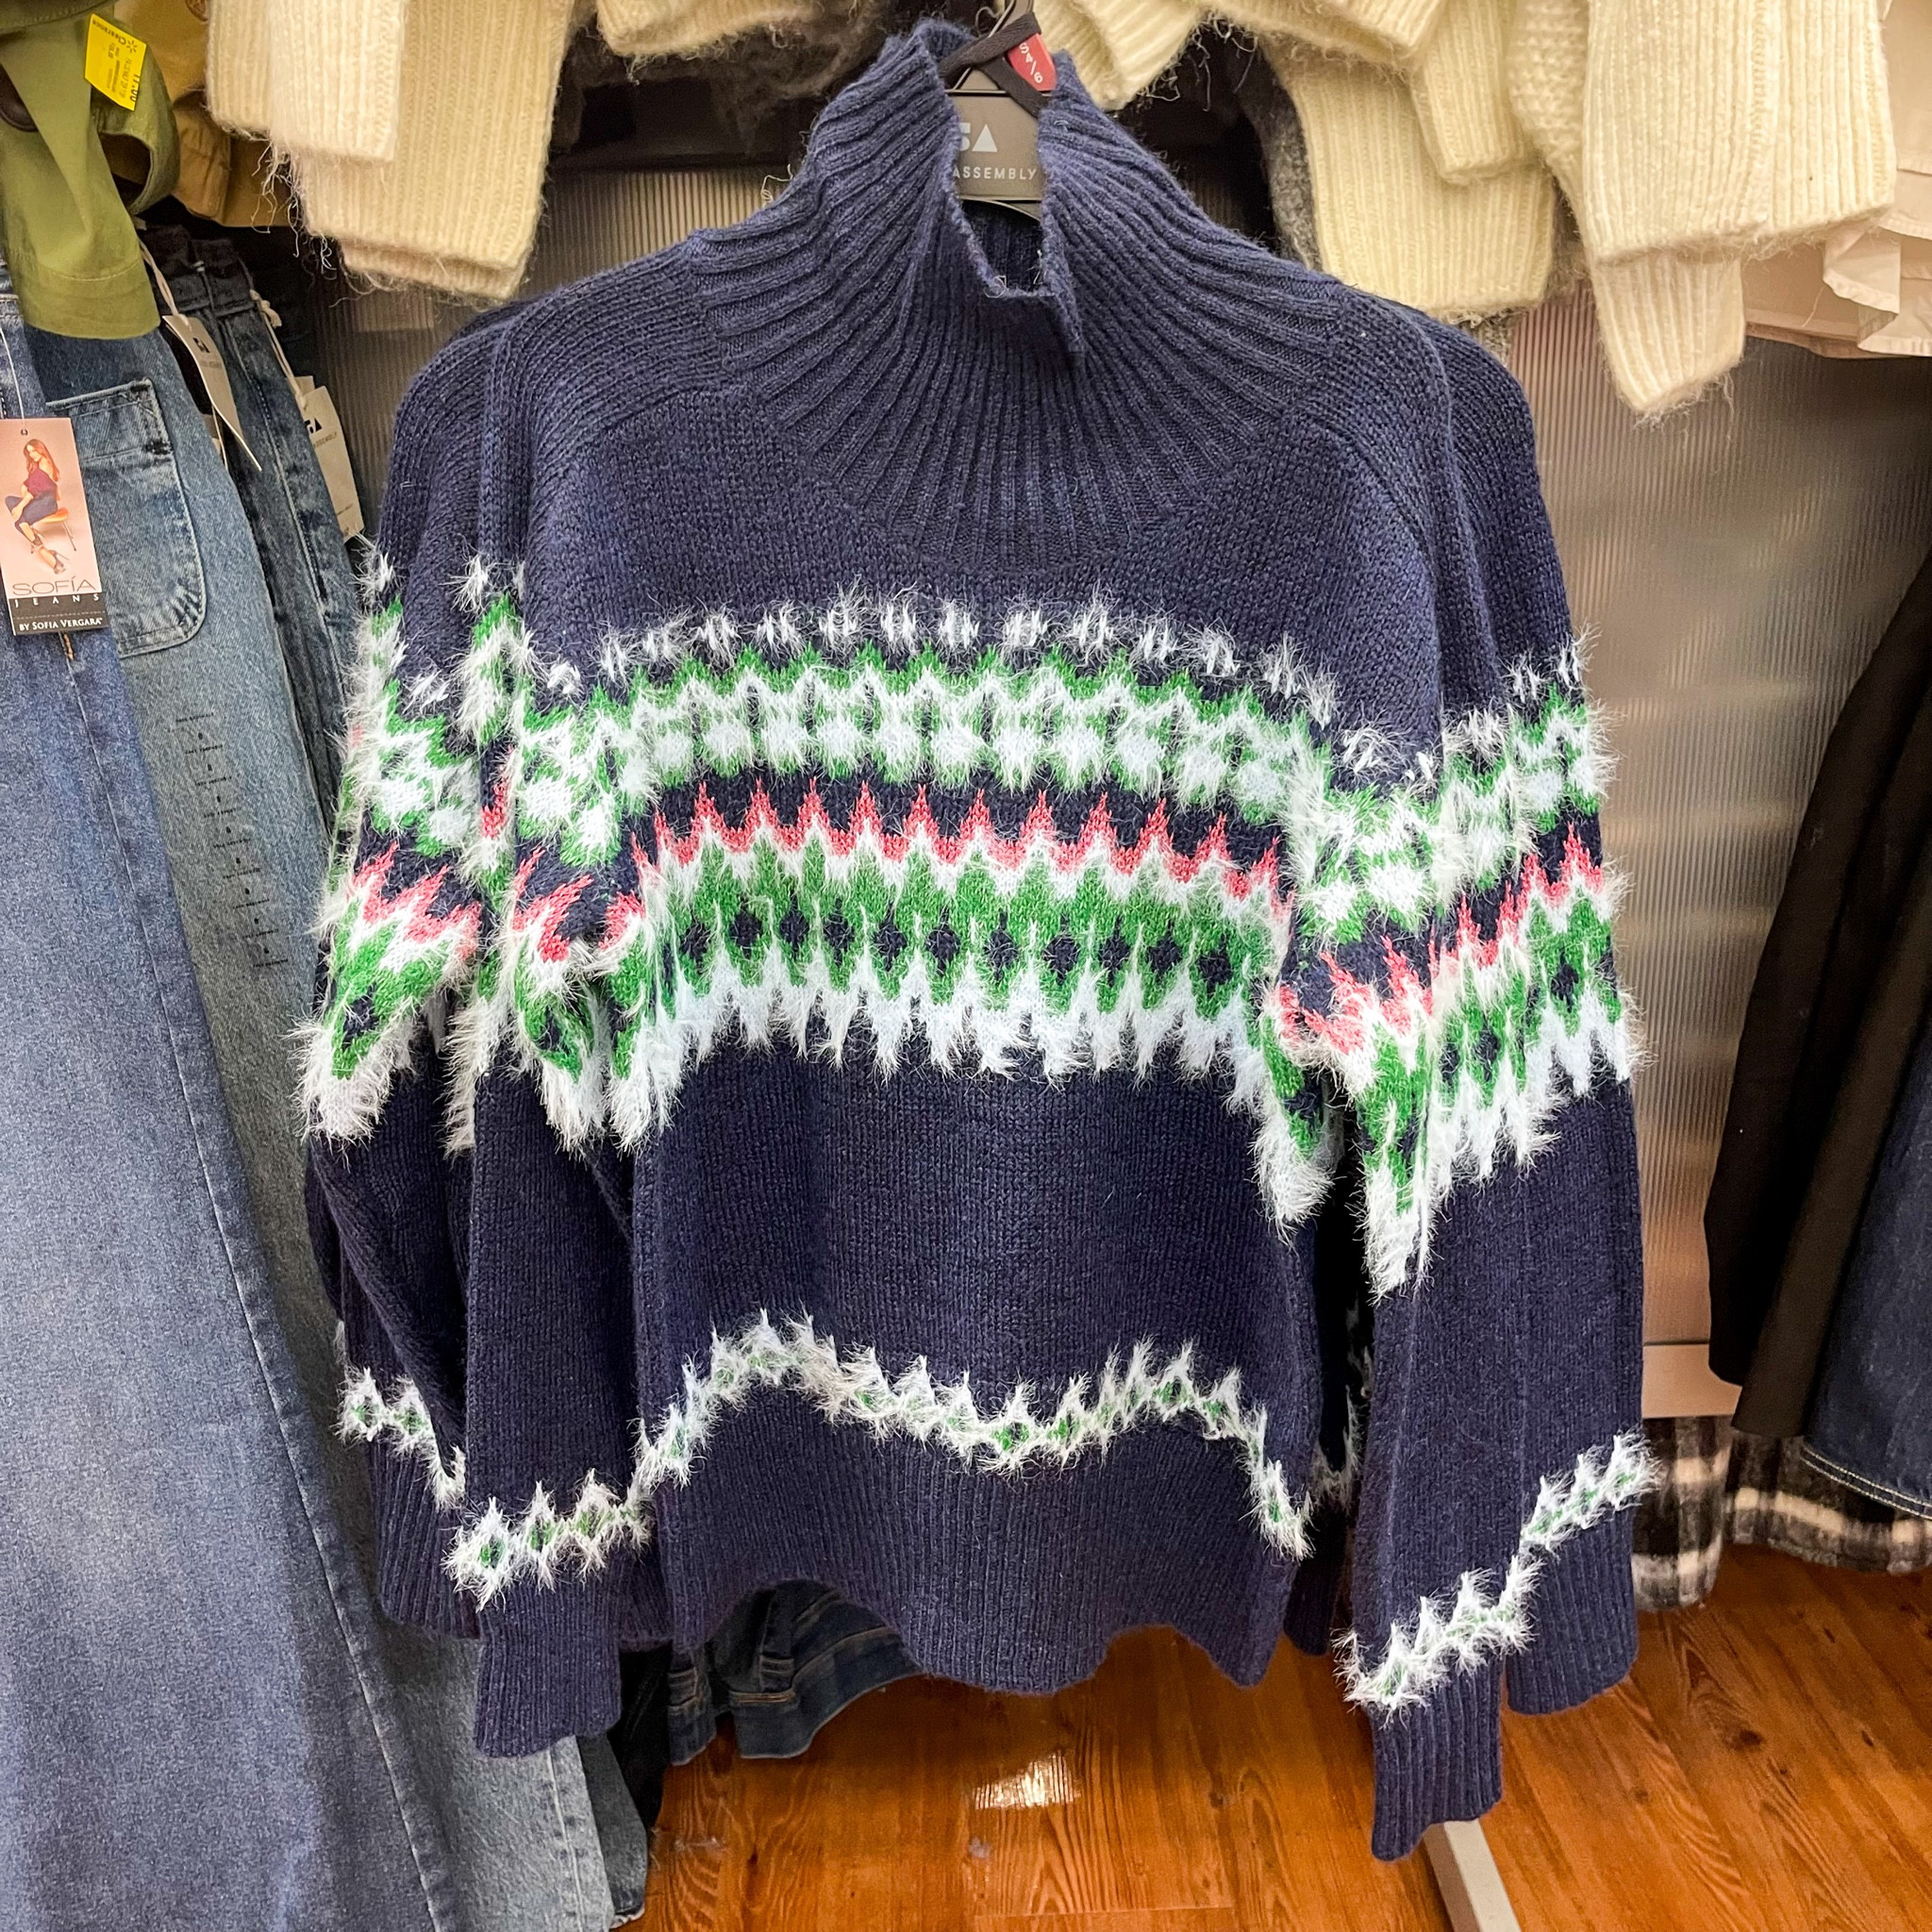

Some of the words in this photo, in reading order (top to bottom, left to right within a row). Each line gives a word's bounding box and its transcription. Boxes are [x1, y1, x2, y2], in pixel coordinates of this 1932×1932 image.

[952, 166, 1037, 180] ASSEMBLY
[12, 575, 97, 596] SOFÍA
[14, 592, 99, 608] JEANS
[19, 623, 30, 632] BY
[32, 620, 59, 631] SOFIA
